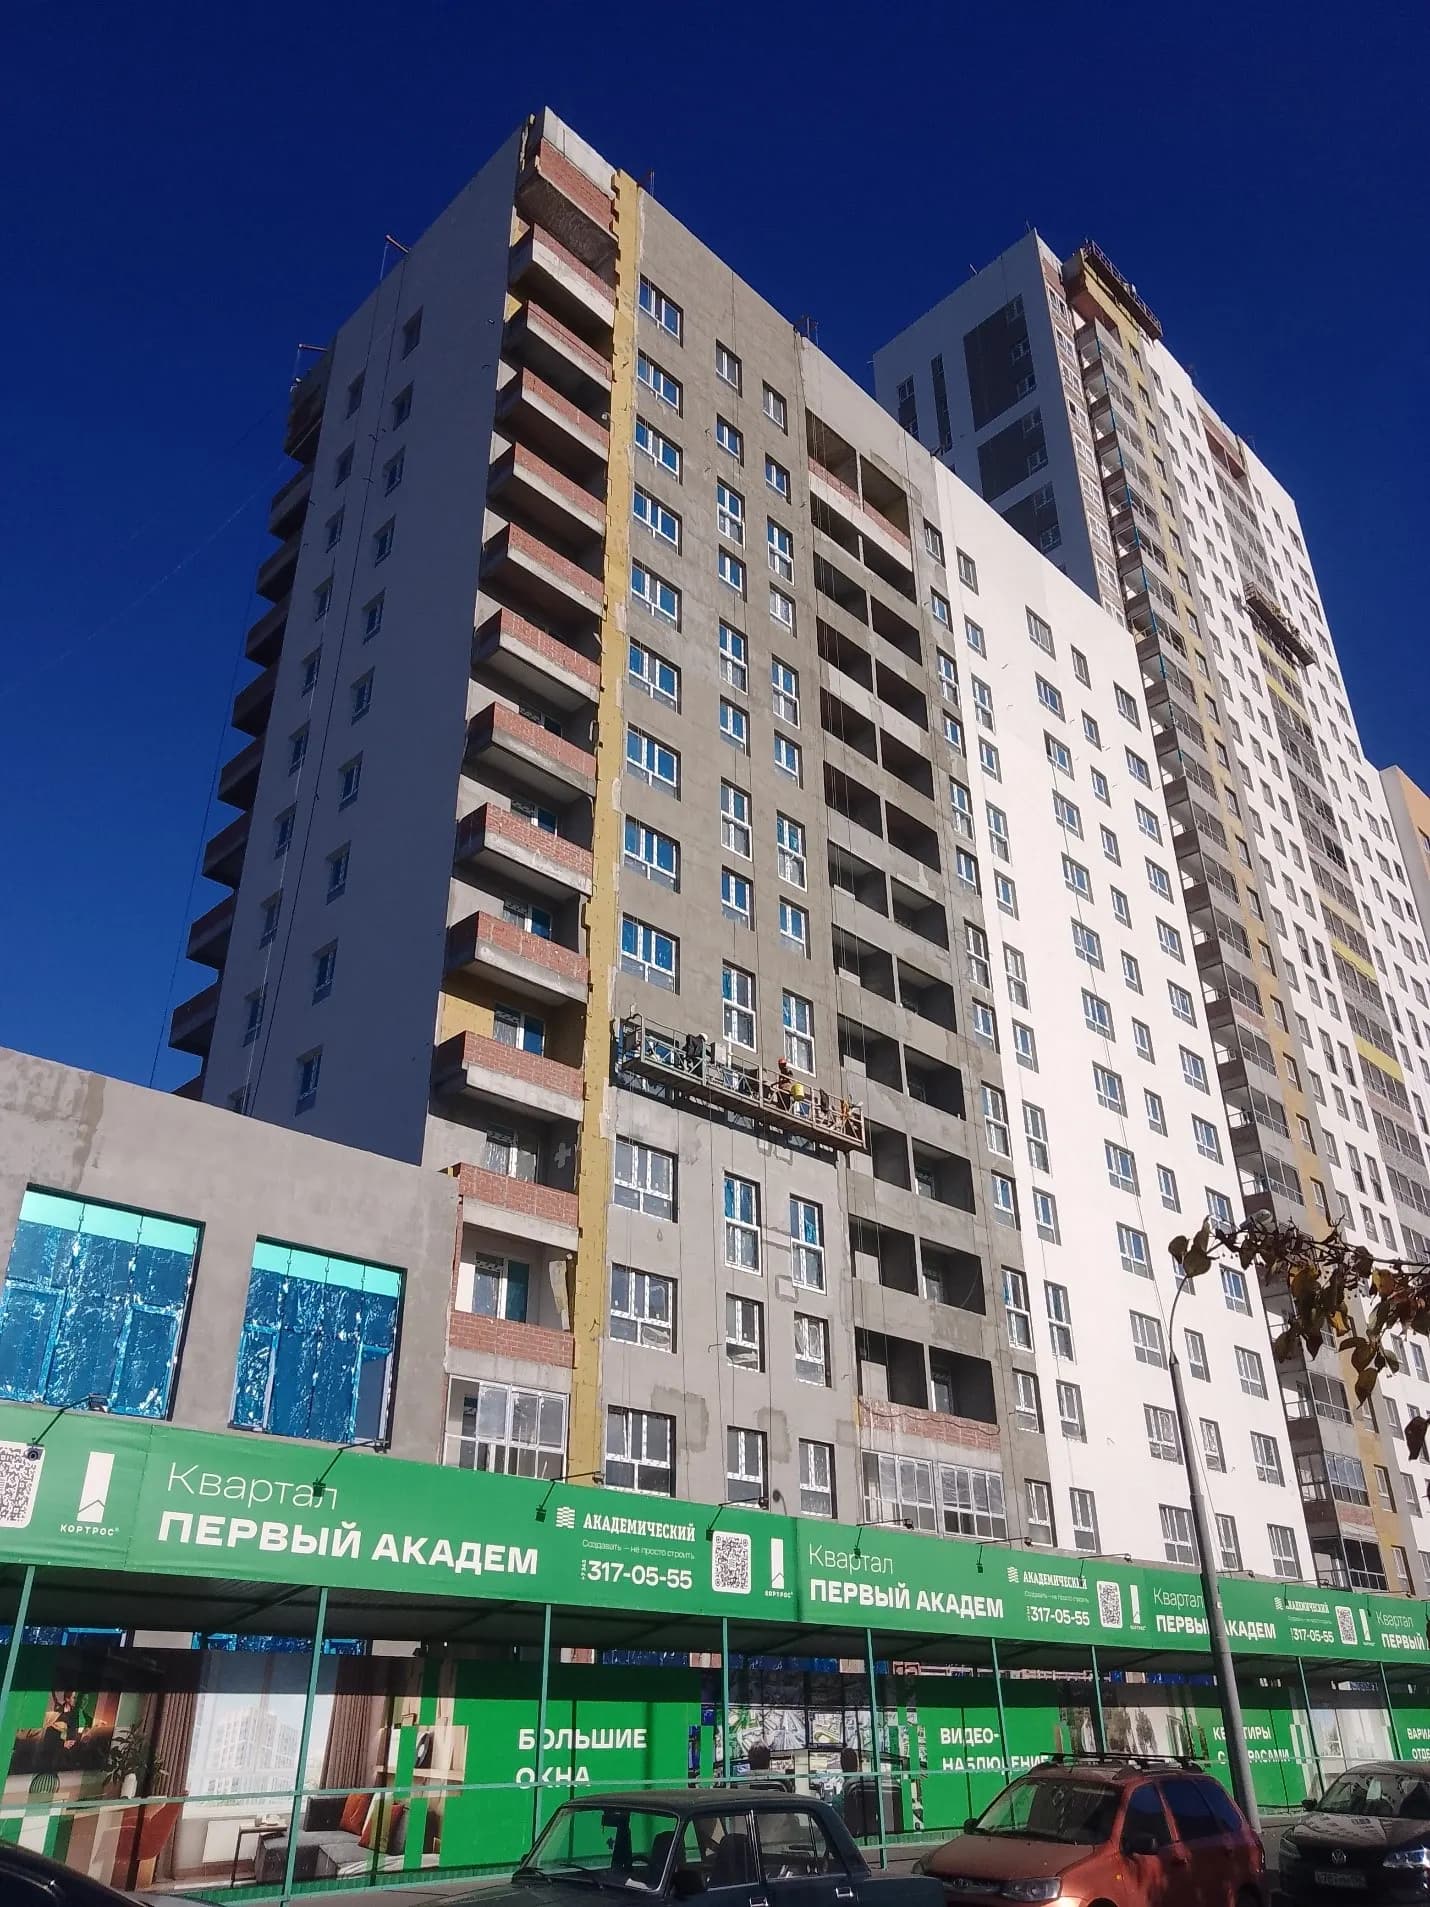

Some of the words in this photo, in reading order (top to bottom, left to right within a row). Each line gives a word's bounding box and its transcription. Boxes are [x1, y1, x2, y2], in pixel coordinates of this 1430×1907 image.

[167, 1461, 338, 1510] Квартал
[583, 1512, 696, 1542] АКАДЕМИЧЕСКИЙ
[158, 1511, 361, 1559] ПЕРВЫЙ
[371, 1533, 538, 1576] АКАДЕМ
[809, 1543, 893, 1575] Квартал
[587, 1560, 693, 1590] 317-05-55
[810, 1578, 910, 1610] ПЕРВЫЙ
[916, 1590, 1004, 1620] АКАДЕМ
[1030, 1606, 1090, 1626] 317-05-55
[1156, 1614, 1210, 1635] ПЕРВЫ
[1375, 1610, 1414, 1630] Квартал
[1381, 1632, 1425, 1651] ПЕРВЫЙ
[518, 1728, 647, 1750] БОЛЬШИЕ
[940, 1727, 1000, 1747] ВИДЕО-
[1213, 1726, 1272, 1740] КВТИРЫ
